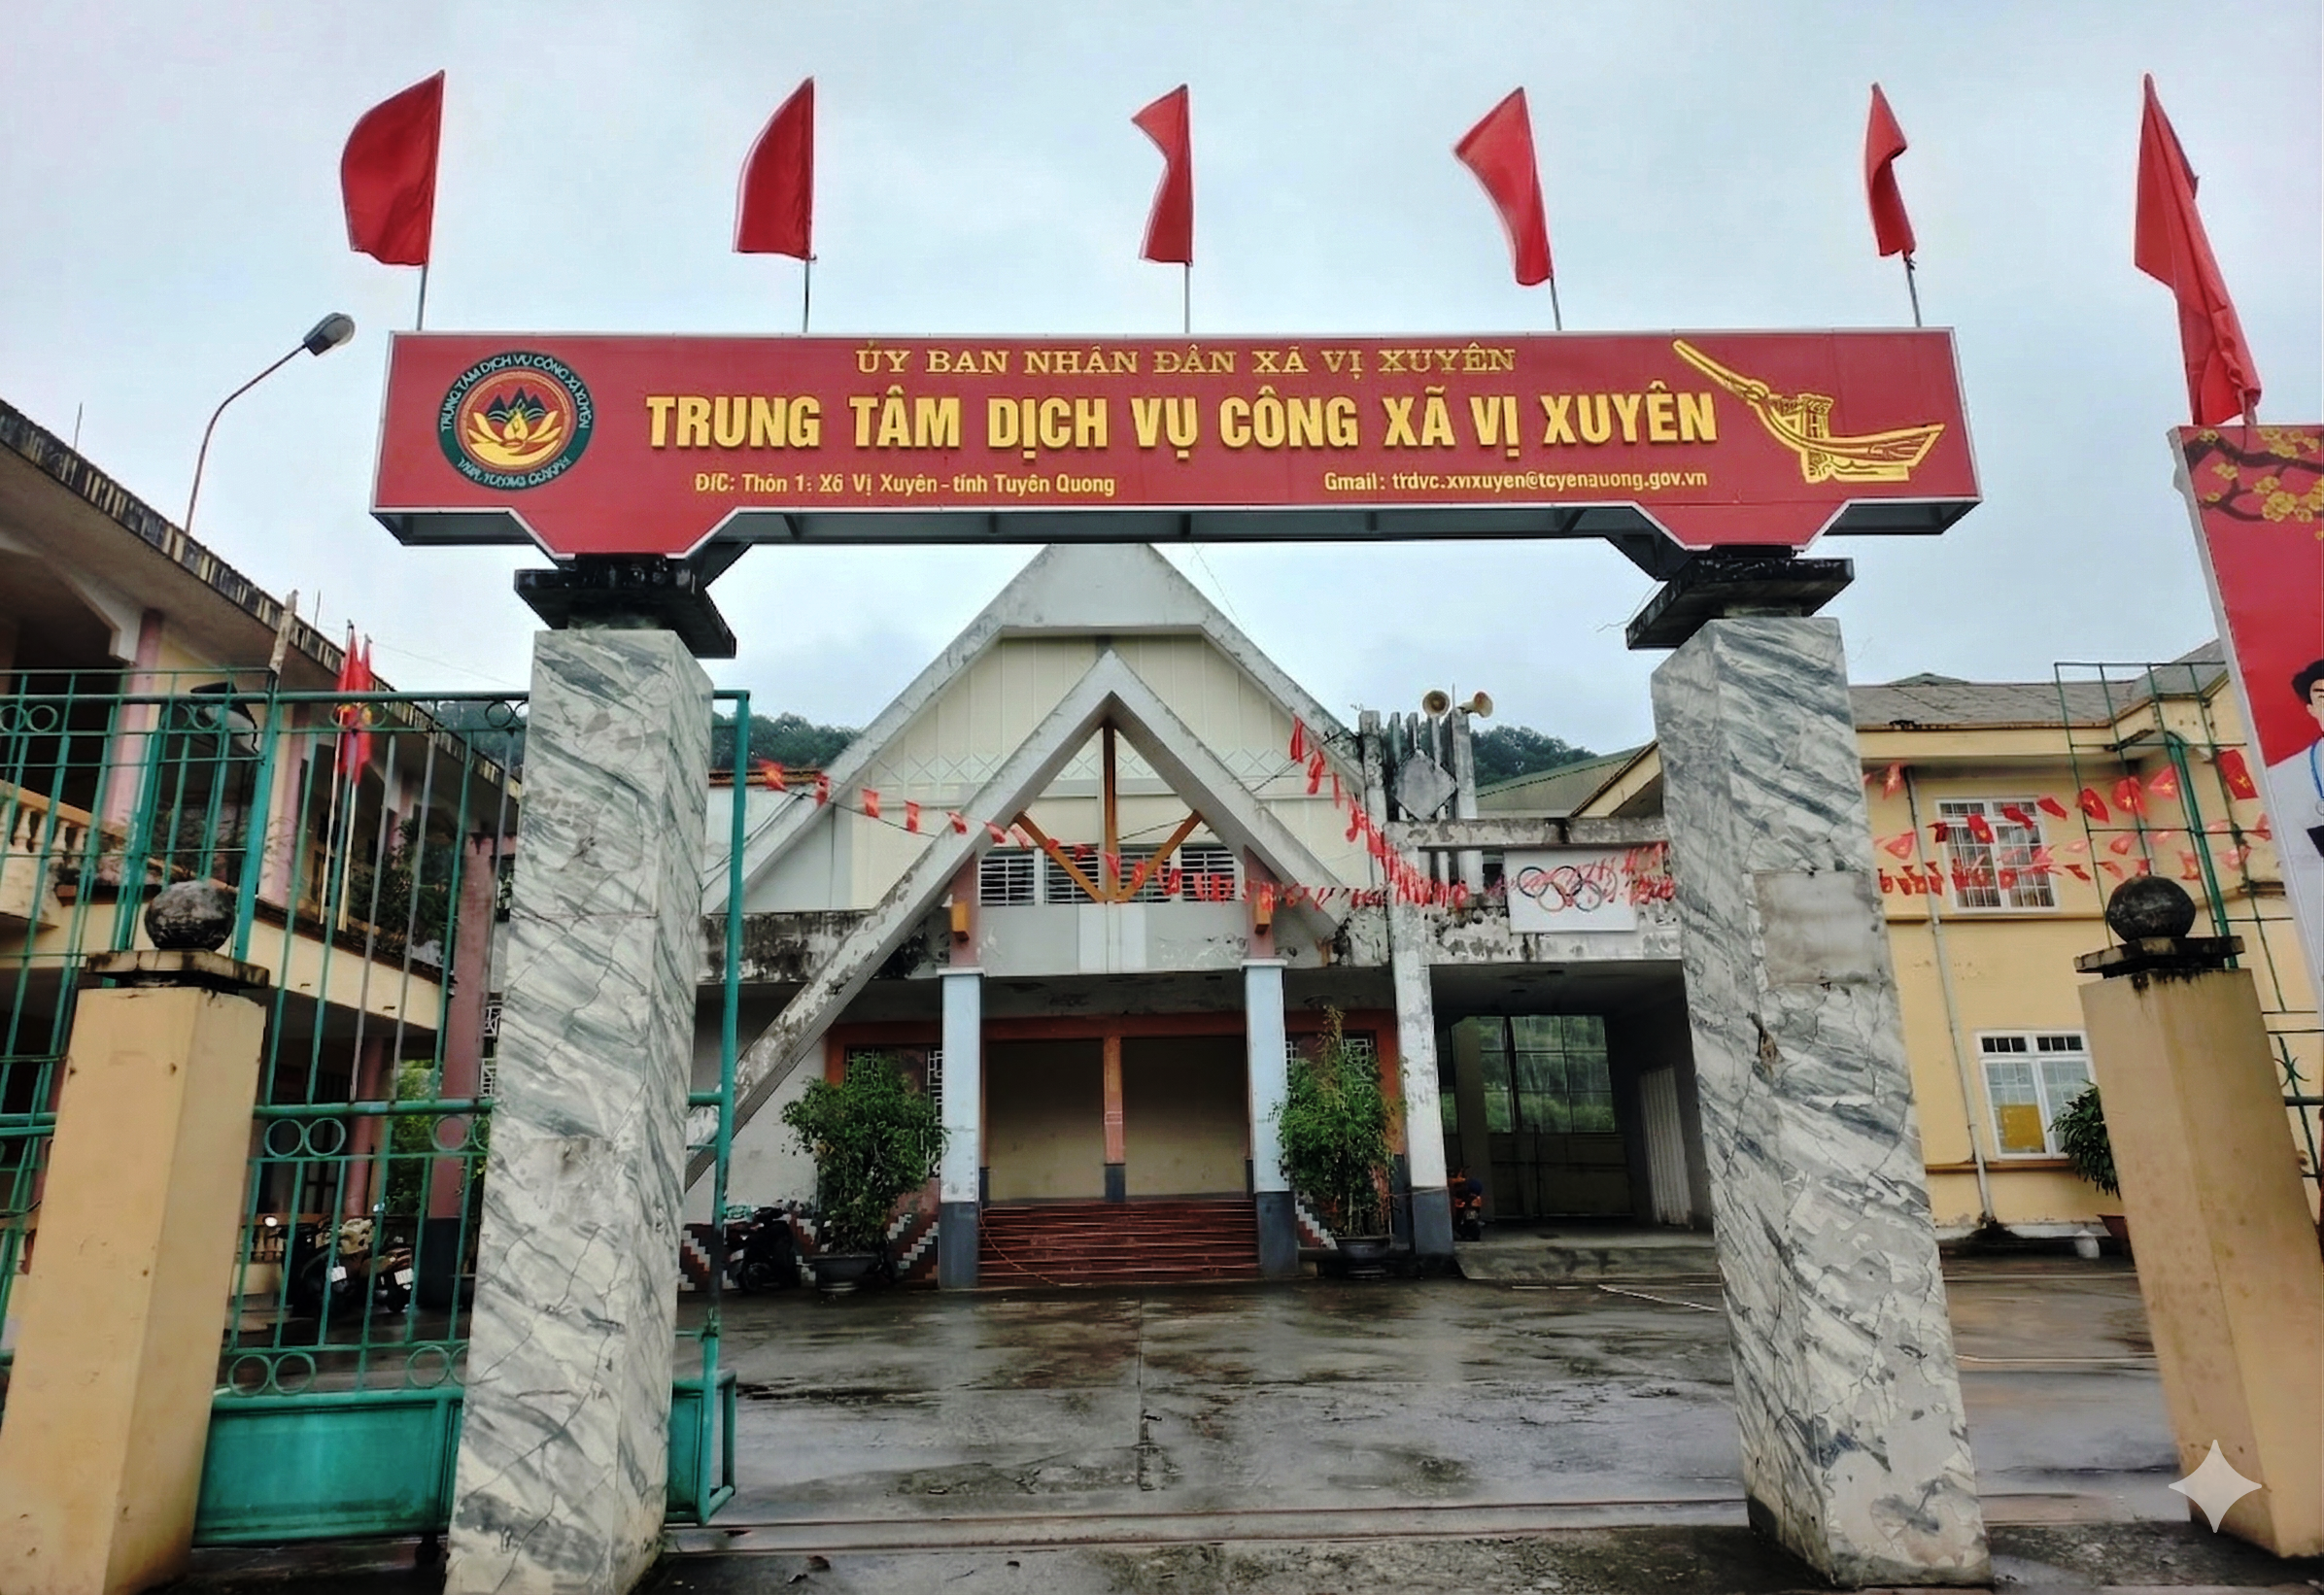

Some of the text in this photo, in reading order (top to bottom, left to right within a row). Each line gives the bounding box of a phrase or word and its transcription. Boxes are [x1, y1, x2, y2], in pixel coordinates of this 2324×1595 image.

[926, 349, 1009, 374] BAN
[1023, 345, 1139, 374] NHÂN
[1252, 346, 1309, 373] XÃ
[1321, 349, 1363, 380] VỊ
[1378, 342, 1516, 373] XUYÊN
[646, 380, 1719, 459] TRUNG TÂM DỊCH VỤ CÔNG XÃ VỊ XUYÊN
[852, 473, 872, 496] Vị
[879, 473, 938, 496] Xuyên
[993, 473, 1050, 497] Tuyên
